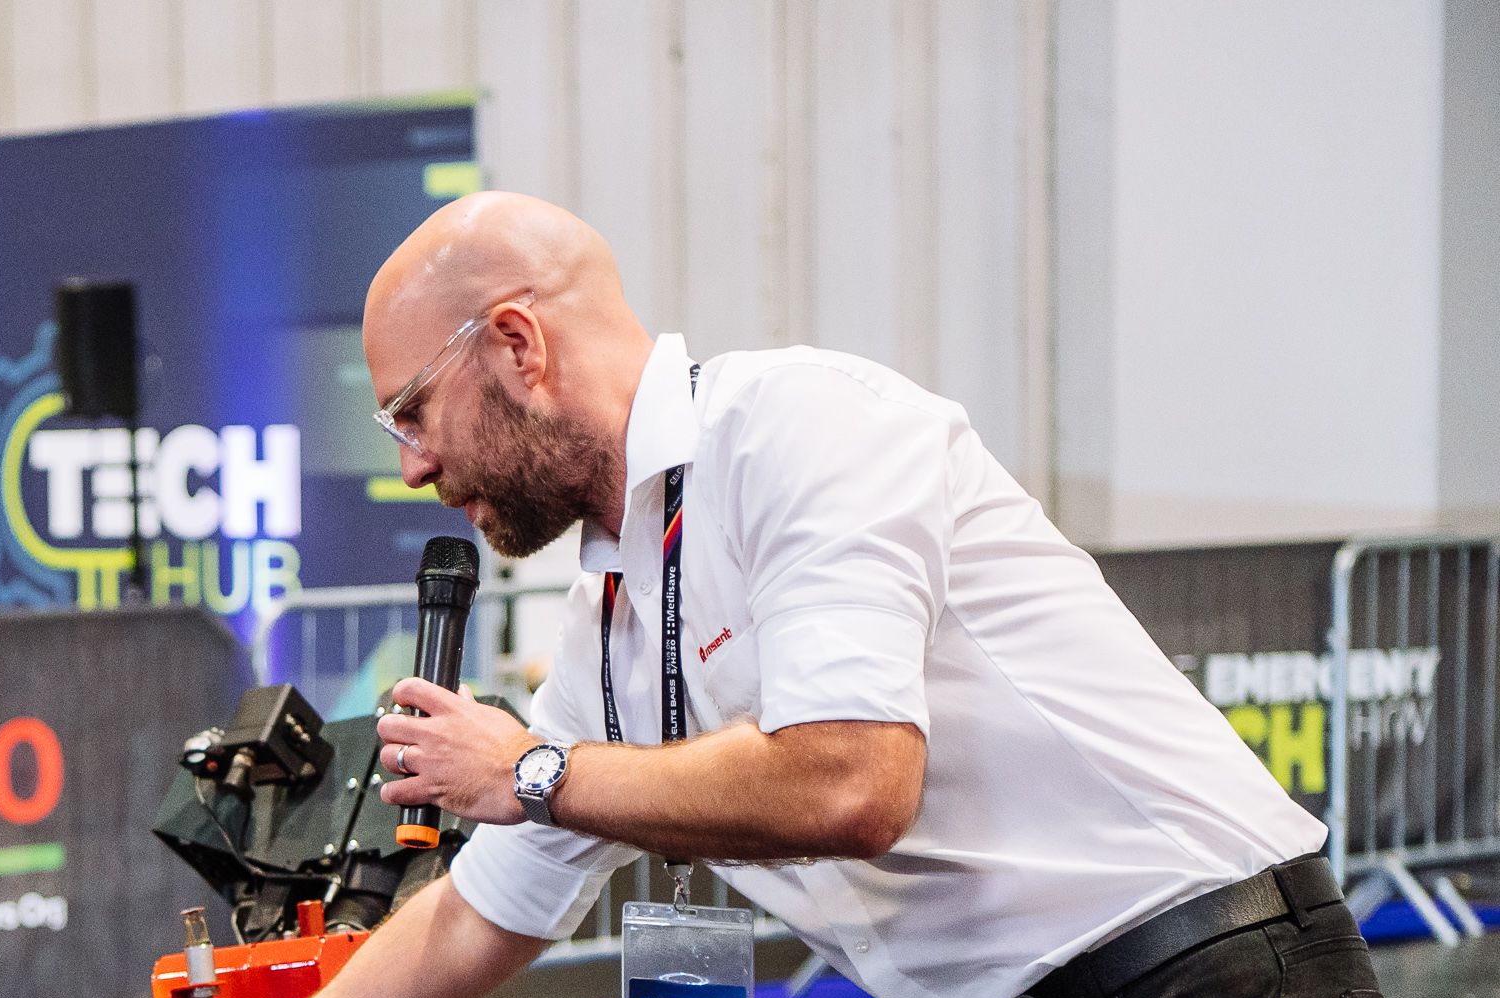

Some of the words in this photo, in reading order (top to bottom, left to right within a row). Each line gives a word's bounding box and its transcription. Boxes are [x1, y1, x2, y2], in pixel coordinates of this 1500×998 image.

[30, 424, 301, 539] TECH
[151, 539, 302, 617] HUB
[666, 566, 677, 621] Medisave
[669, 679, 677, 707] BAGS
